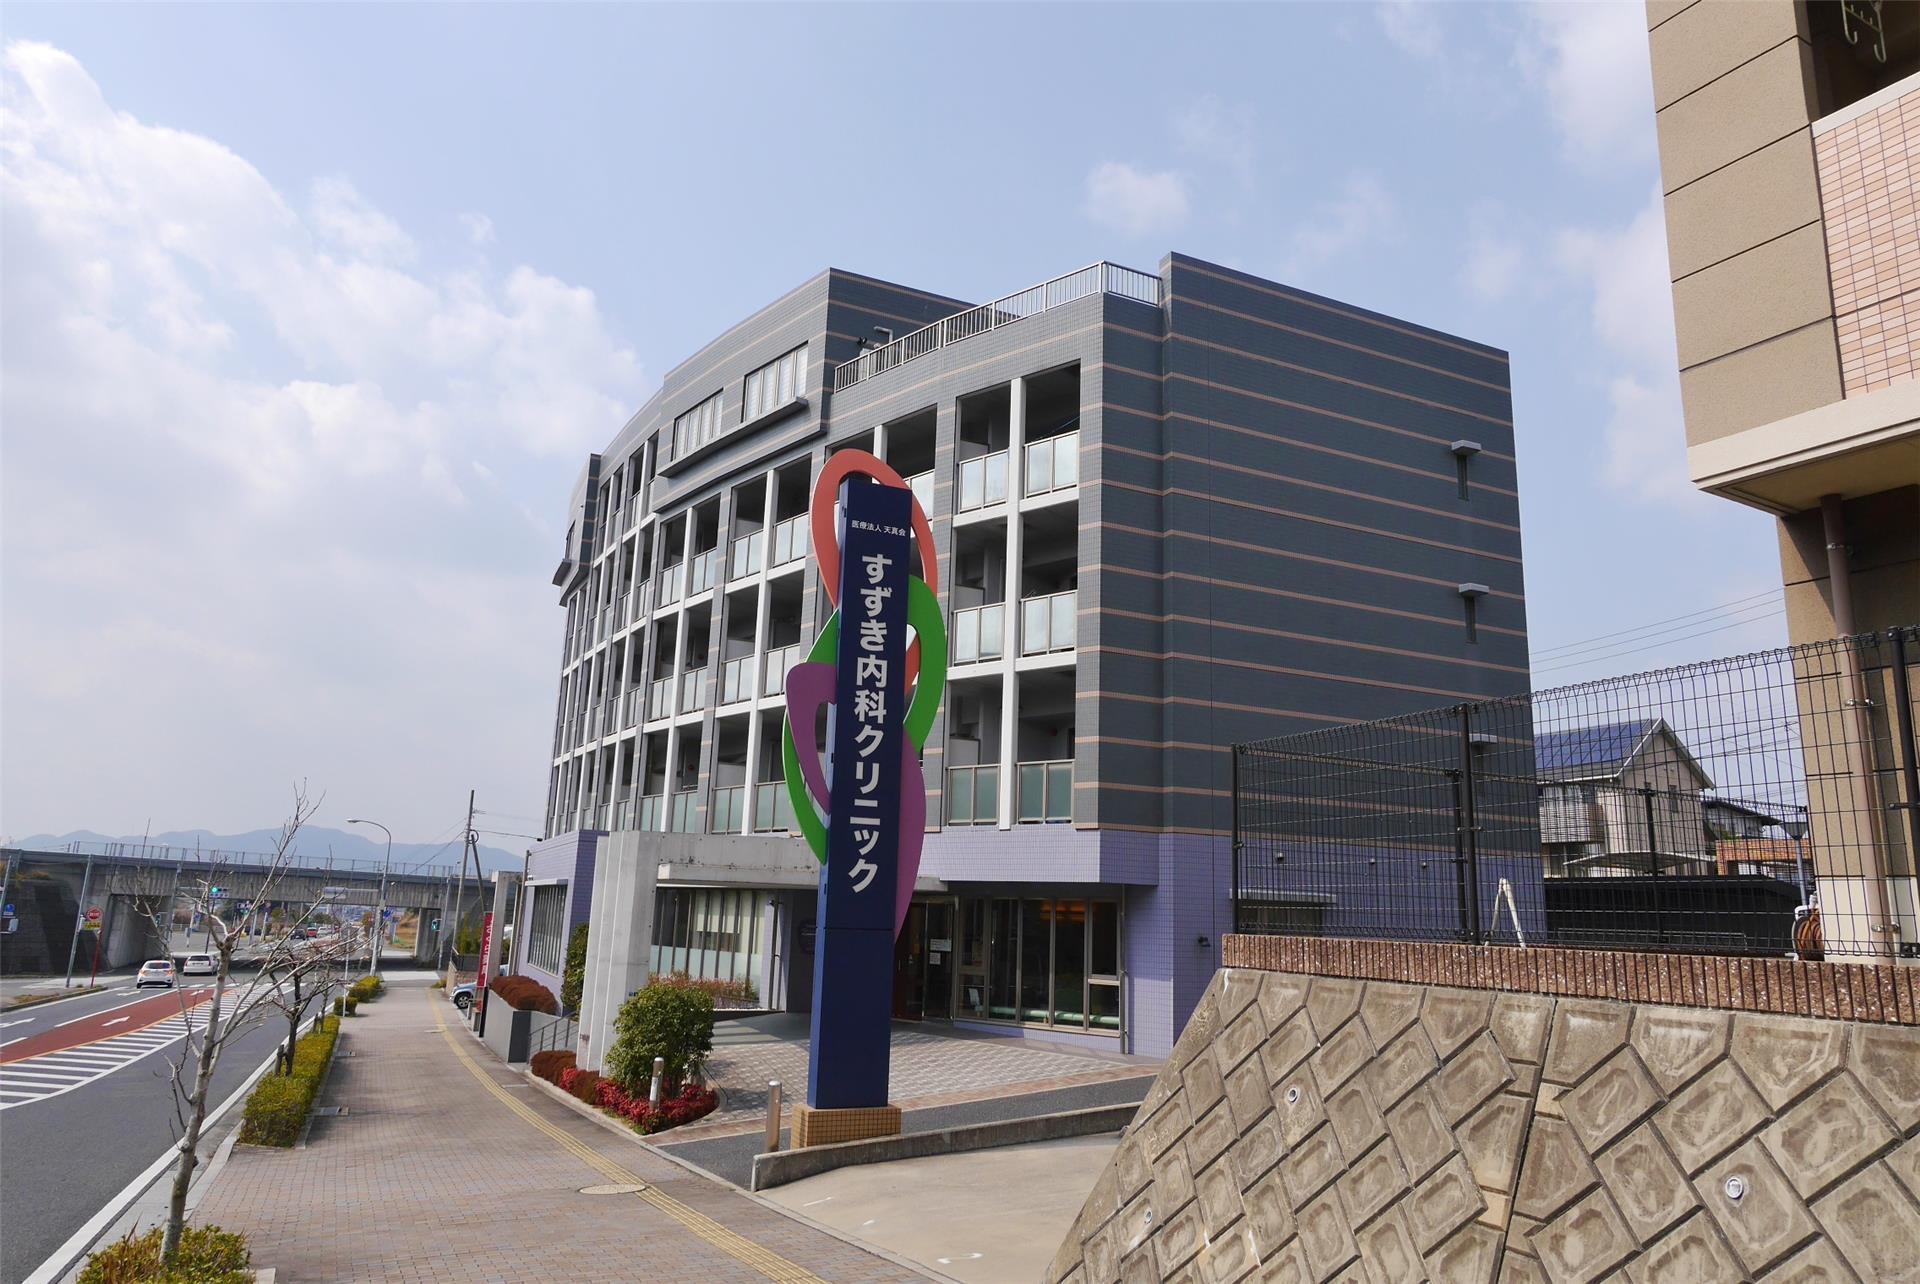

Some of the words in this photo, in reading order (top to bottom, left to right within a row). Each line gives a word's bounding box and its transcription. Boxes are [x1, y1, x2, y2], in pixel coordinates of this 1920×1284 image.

[851, 519, 882, 533] 医療法人
[848, 553, 893, 894] すずき内科クリニック
